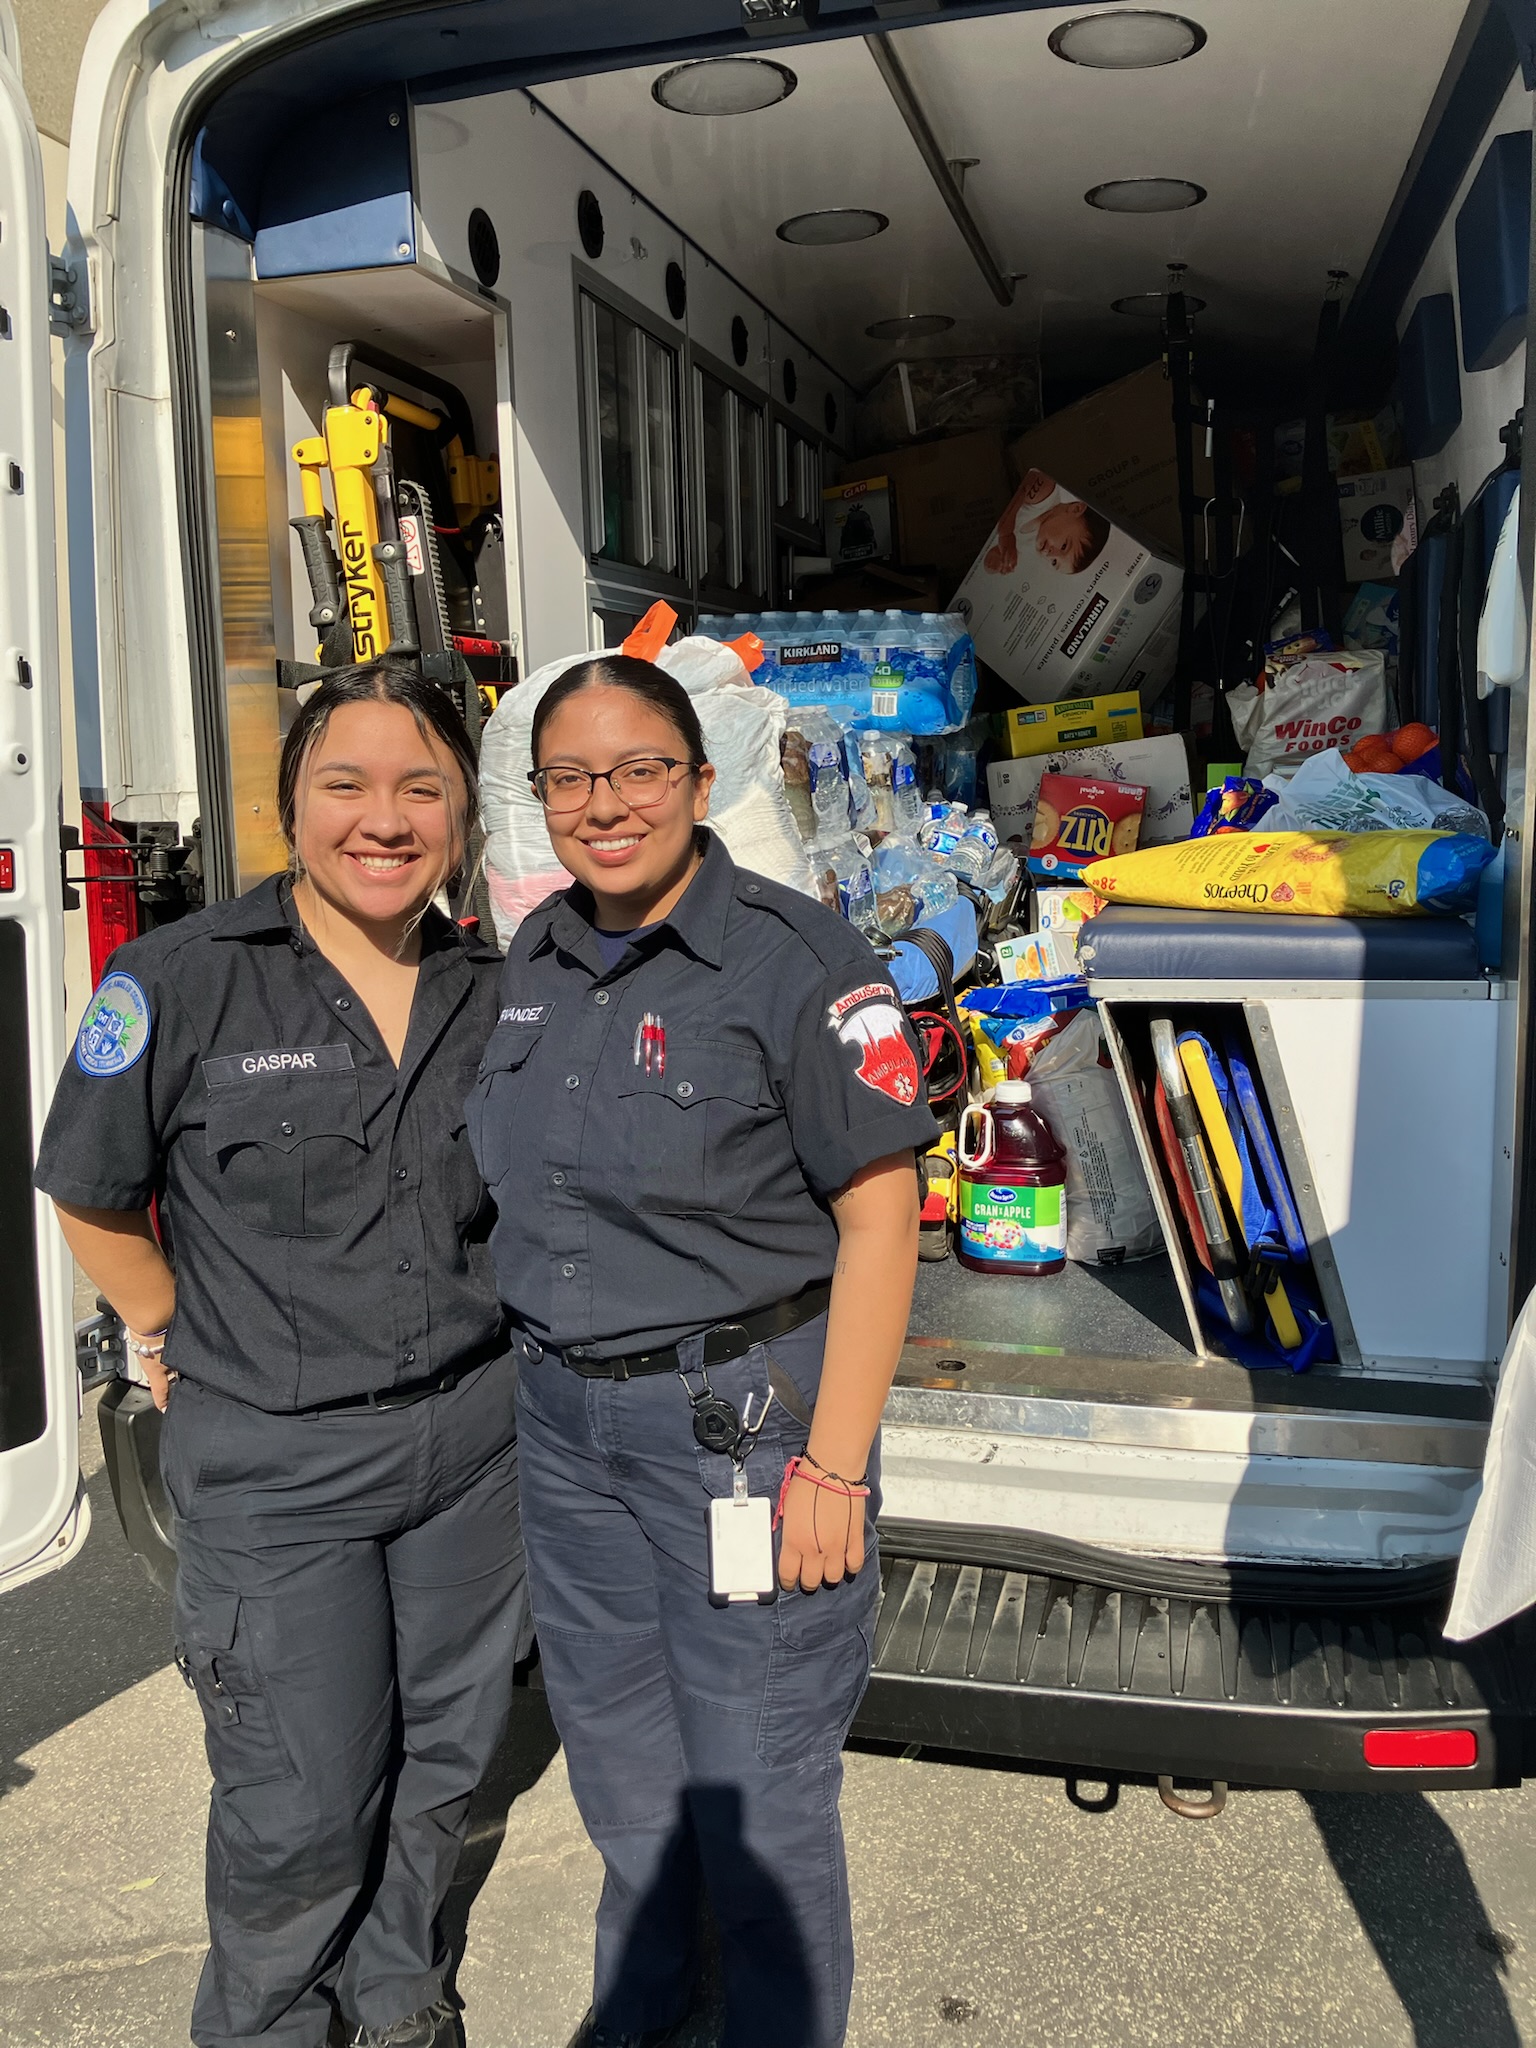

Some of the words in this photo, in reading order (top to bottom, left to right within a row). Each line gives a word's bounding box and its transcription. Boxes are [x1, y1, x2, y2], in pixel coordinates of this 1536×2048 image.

[1087, 460, 1128, 487] GROUP
[843, 483, 867, 499] GLAD
[1026, 477, 1044, 499] 222
[1374, 508, 1386, 539] Millie
[1086, 560, 1110, 594] diapers
[342, 520, 376, 659] stryker
[1065, 598, 1086, 635] couches
[1066, 598, 1107, 656] KIRKLAND
[784, 644, 839, 658] KIRKLAND
[1036, 636, 1061, 671] pañales
[874, 666, 891, 676] 40
[821, 679, 864, 692] water
[1275, 716, 1362, 740] WinCo
[1284, 734, 1351, 752] FOODS
[1057, 815, 1114, 856] RITZ
[1046, 859, 1052, 868] 8
[1101, 877, 1118, 891] 28
[1204, 883, 1268, 904] Cheerios
[834, 985, 892, 1015] AmbuServe
[242, 1053, 317, 1074] GASPAR
[974, 1203, 998, 1217] CRAN
[1004, 1205, 1031, 1218] APPLE
